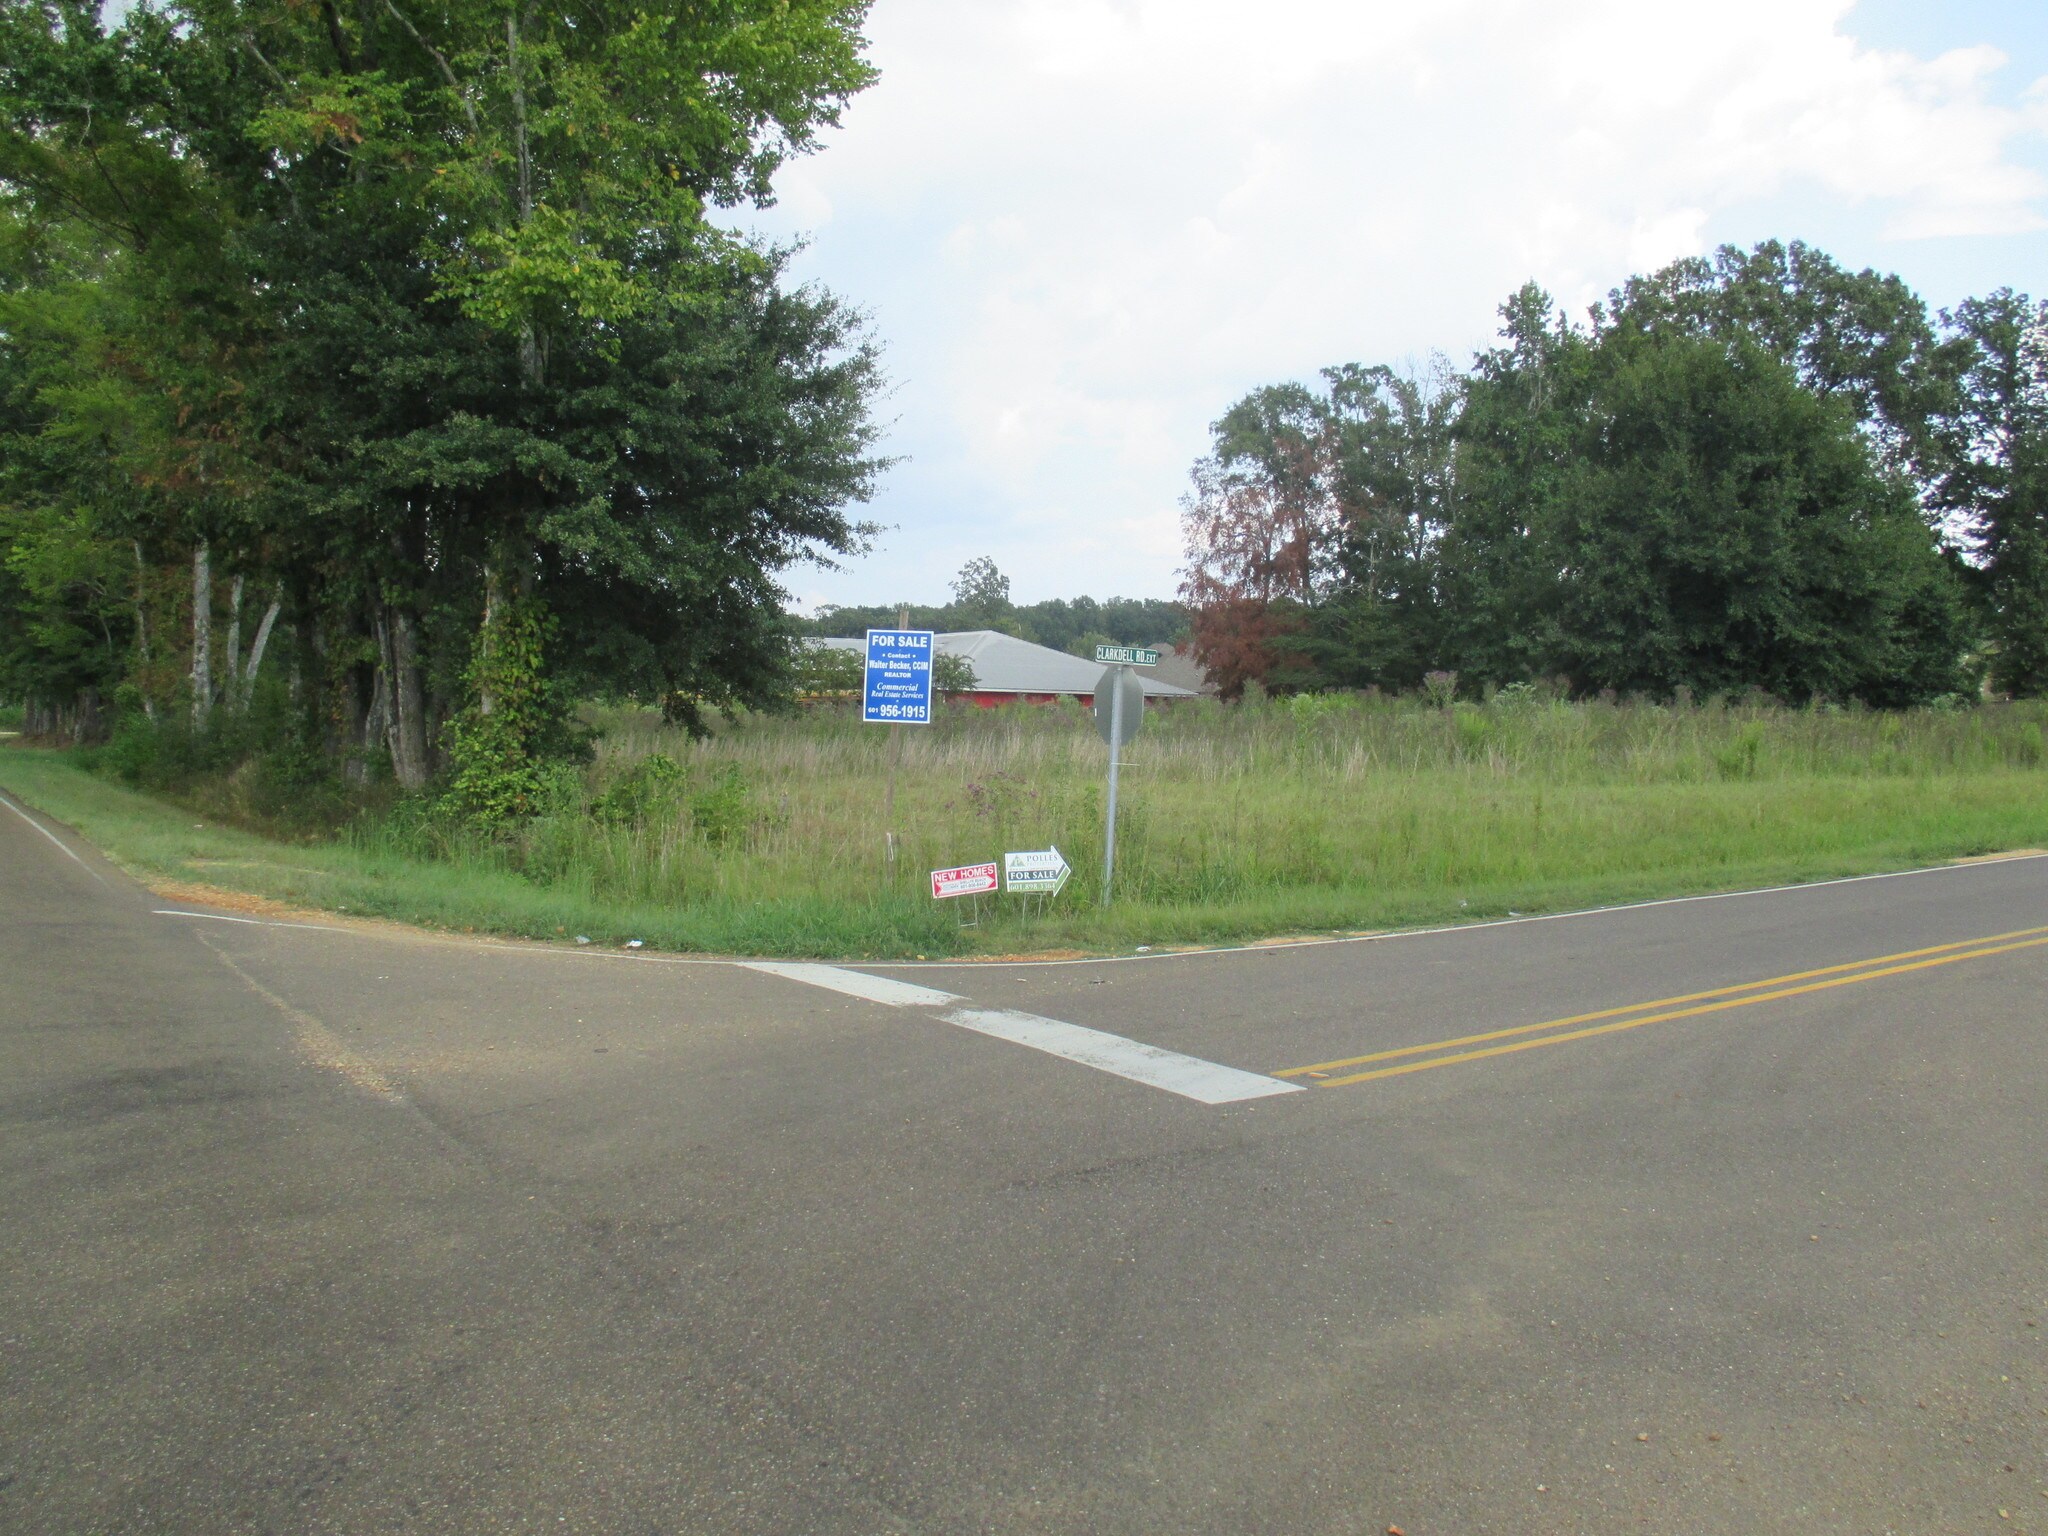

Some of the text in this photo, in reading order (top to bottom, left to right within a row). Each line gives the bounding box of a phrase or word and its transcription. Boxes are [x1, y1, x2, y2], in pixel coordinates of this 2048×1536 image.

[872, 635, 928, 648] FOR SALE
[1096, 647, 1134, 662] CLARKDELL
[869, 660, 888, 669] Walter
[889, 661, 912, 671] Becker,
[876, 682, 918, 692] Commercial
[871, 690, 884, 698] Real
[880, 704, 926, 718] 956-1915
[1026, 854, 1058, 862] POLLES
[934, 871, 957, 882] NEW
[960, 866, 994, 879] HOMES
[1010, 870, 1054, 880] FOR SALE
